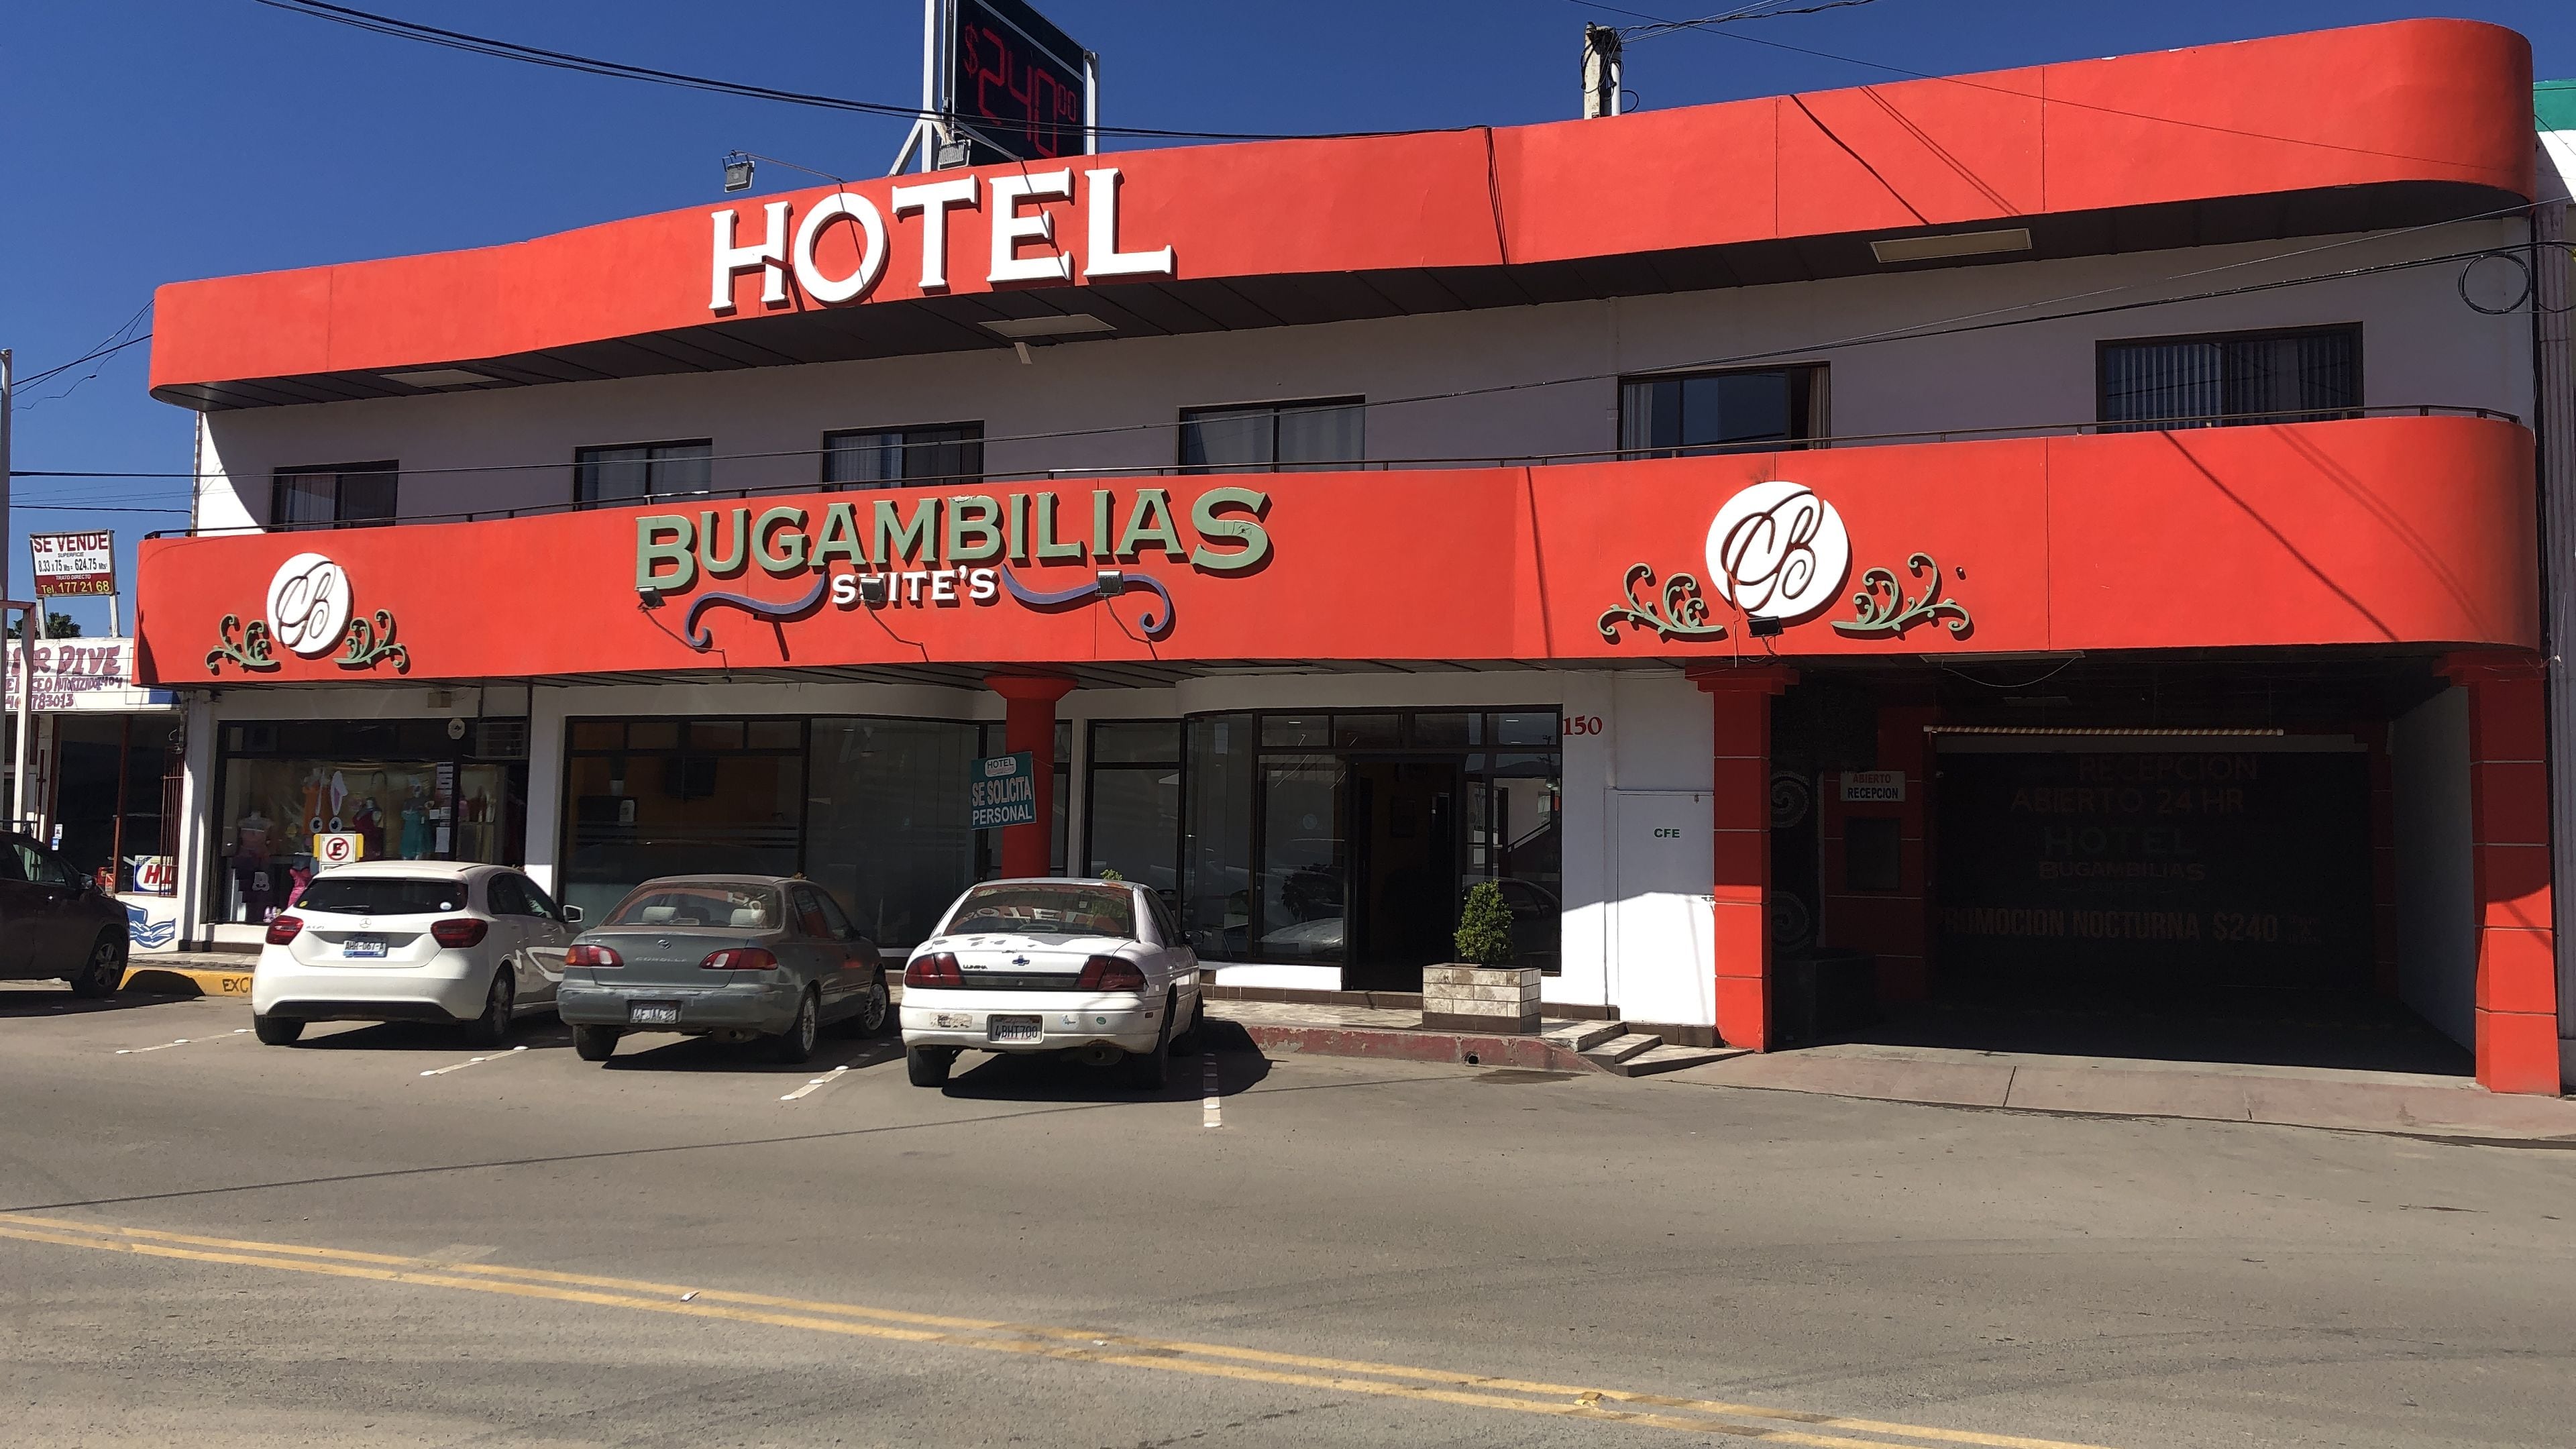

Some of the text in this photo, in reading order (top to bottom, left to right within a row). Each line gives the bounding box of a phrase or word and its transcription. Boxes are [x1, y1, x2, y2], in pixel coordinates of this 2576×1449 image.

[708, 166, 1173, 311] HOTEL
[34, 535, 108, 553] SE VENDE
[635, 488, 1267, 592] BUGAMBILIAS
[74, 558, 97, 571] 624.75
[58, 582, 77, 593] 177
[80, 581, 93, 592] 21
[96, 580, 109, 592] 68
[57, 645, 121, 675] DIVE
[1564, 715, 1603, 736] 150
[987, 758, 1014, 769] HOTEL
[1853, 773, 1892, 784] ABIERTO
[972, 776, 1032, 806] SE SOLICITA
[1847, 787, 1898, 799] RECEPCION
[2011, 787, 2143, 813] ABIERTO
[2157, 787, 2191, 814] 24
[973, 804, 1032, 825] PERSONAL
[1654, 828, 1680, 839] CFE
[2043, 826, 2197, 856] HOTEL
[2039, 861, 2206, 881] BUGAMBILIAS
[2073, 911, 2200, 941] NOCTURNA
[2213, 912, 2279, 942] $240
